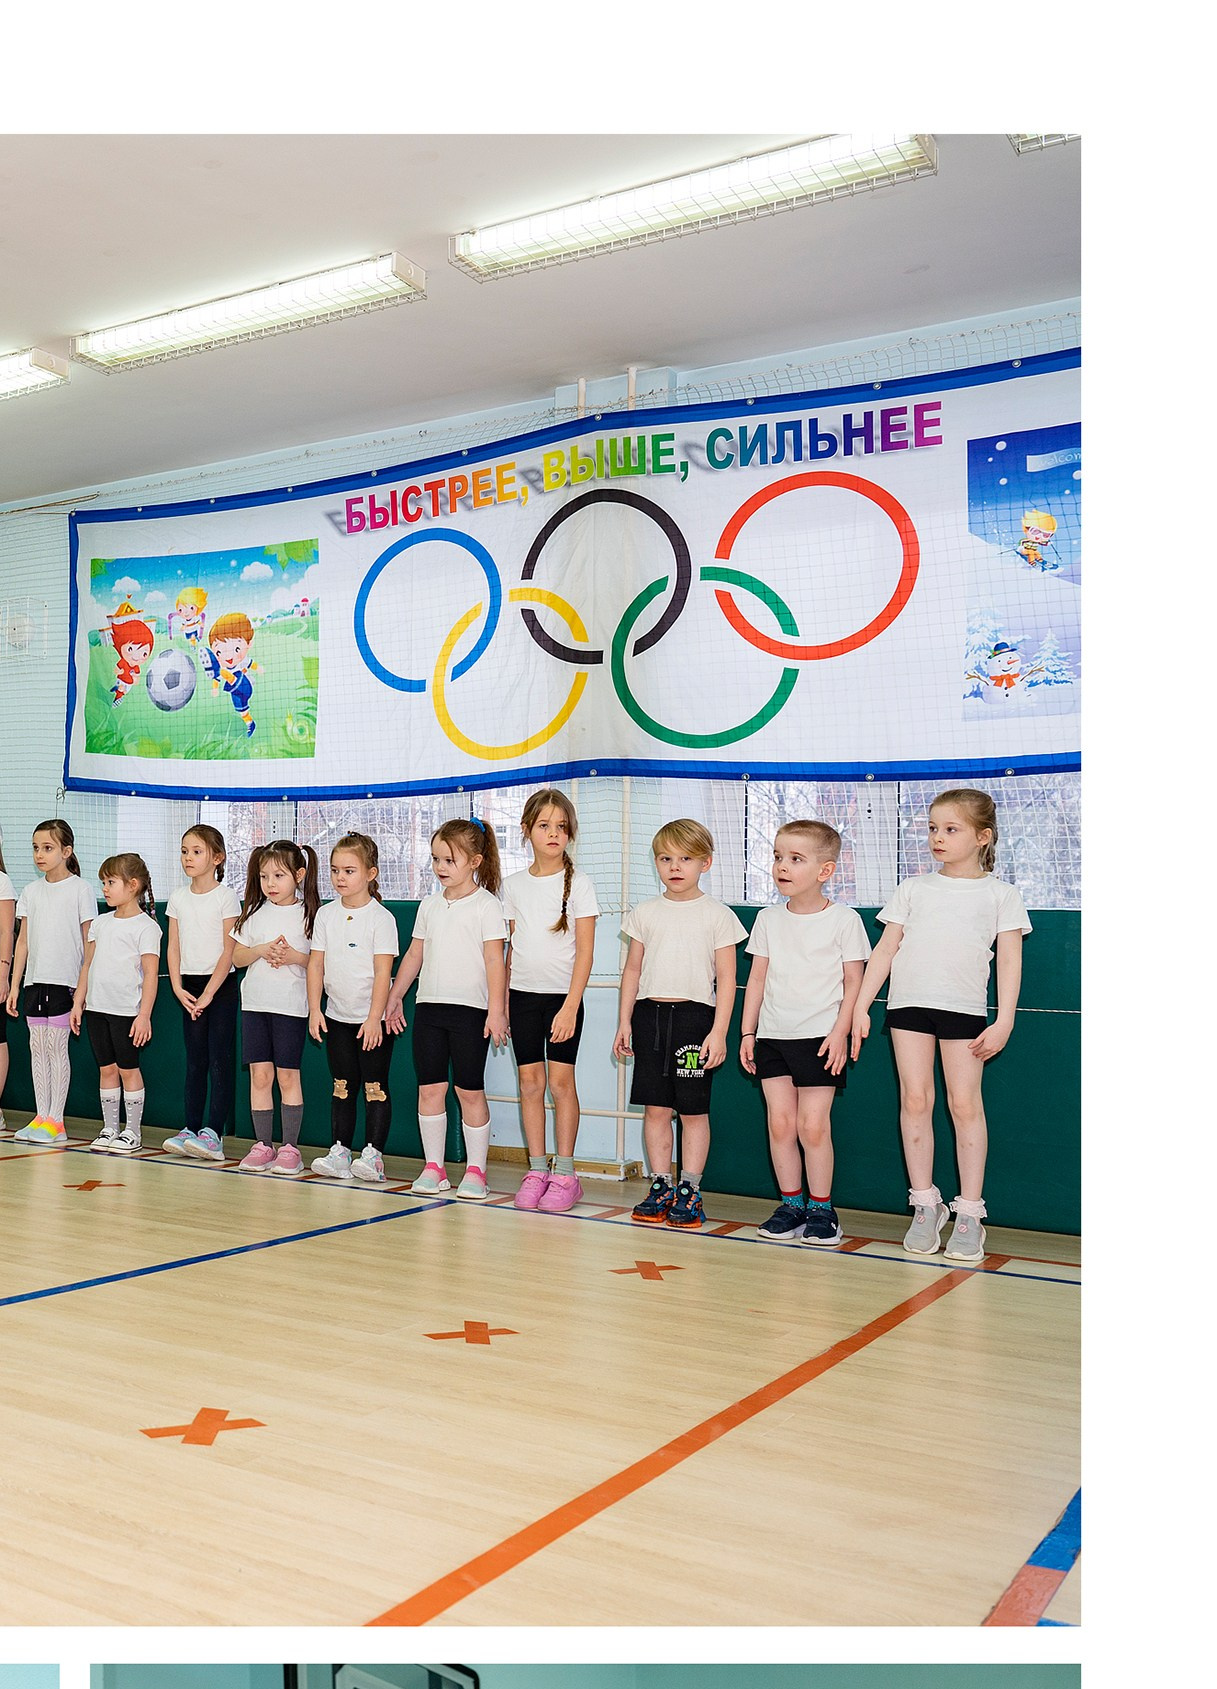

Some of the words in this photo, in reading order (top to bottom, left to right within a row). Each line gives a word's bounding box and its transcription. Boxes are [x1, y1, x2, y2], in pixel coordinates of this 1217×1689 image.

[345, 461, 529, 535] БЫСТРЕЕ,
[542, 432, 689, 492] ВЫШЕ,
[706, 401, 944, 471] СИЛЬНЕЕ
[675, 1044, 708, 1057] CHAMPION
[685, 1052, 699, 1069] N
